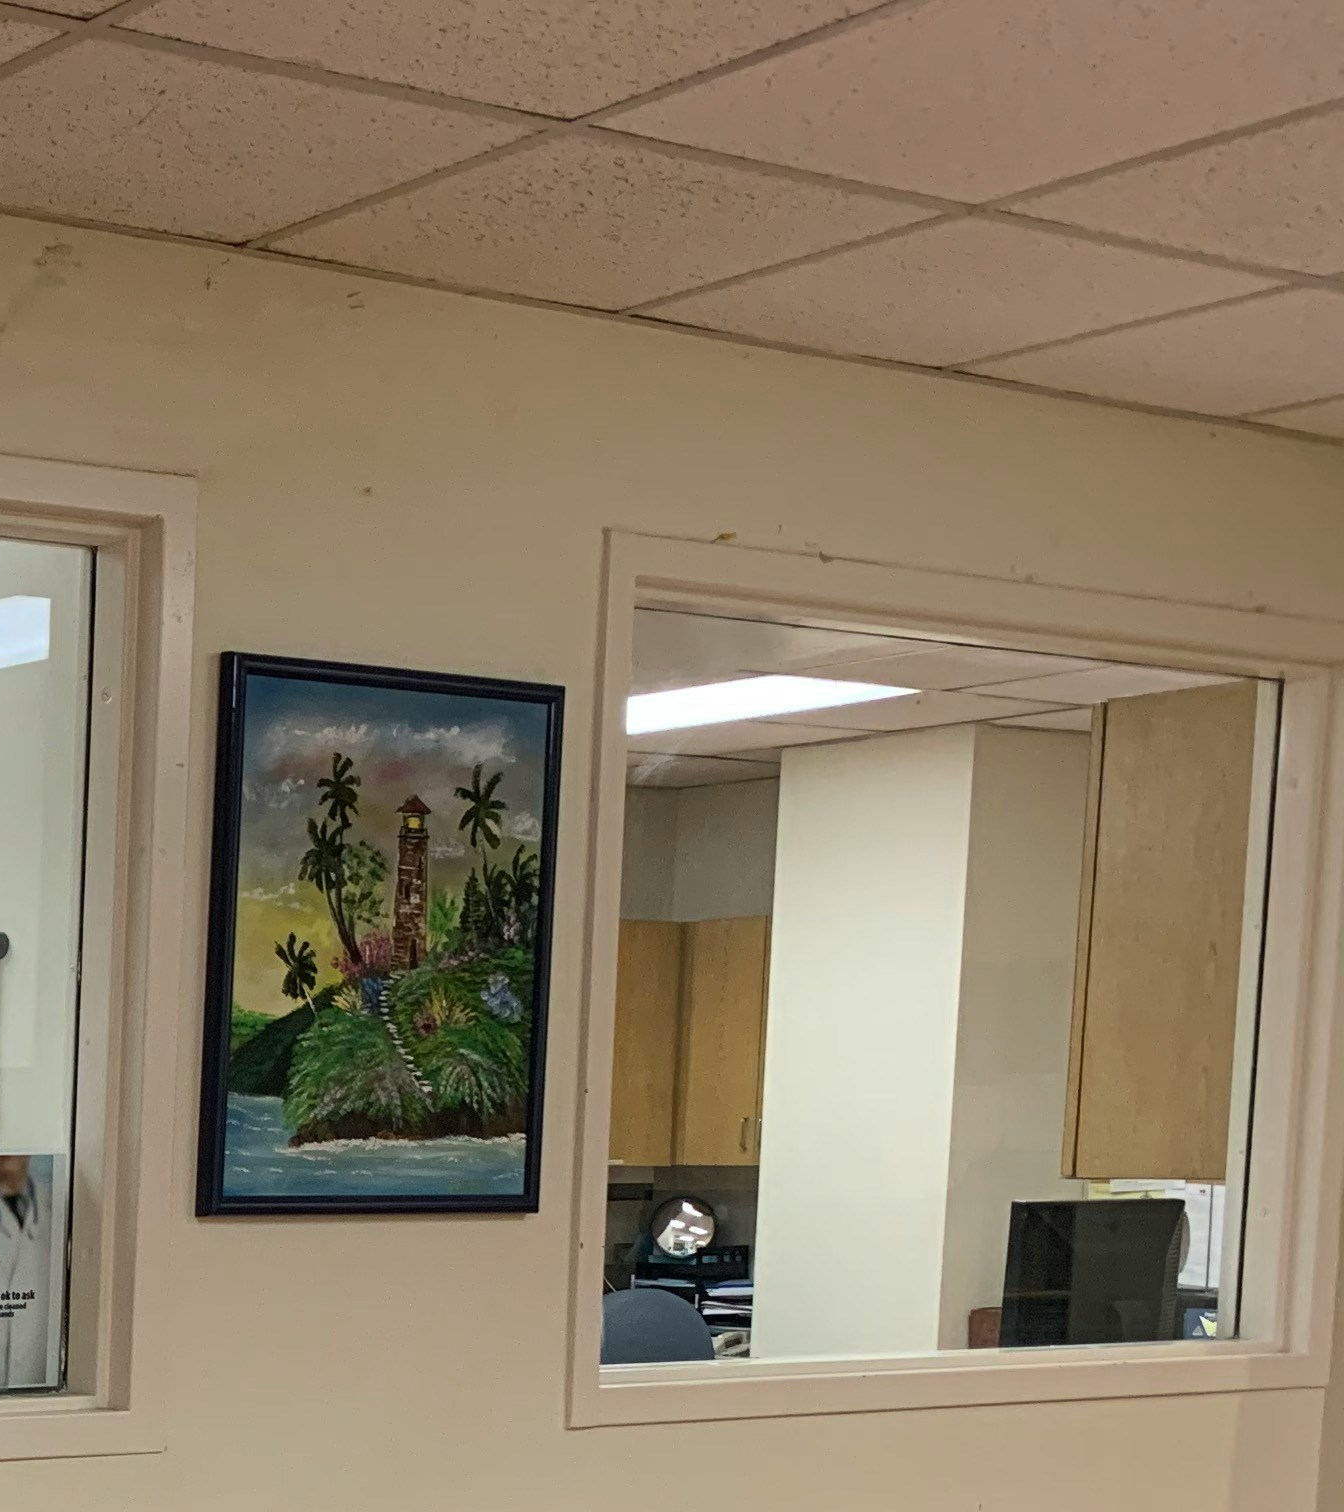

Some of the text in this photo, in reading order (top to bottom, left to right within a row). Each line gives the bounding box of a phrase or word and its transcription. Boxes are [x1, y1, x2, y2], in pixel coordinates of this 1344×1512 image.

[1, 1290, 10, 1300] ok
[12, 1291, 20, 1300] to
[22, 1290, 35, 1300] ask
